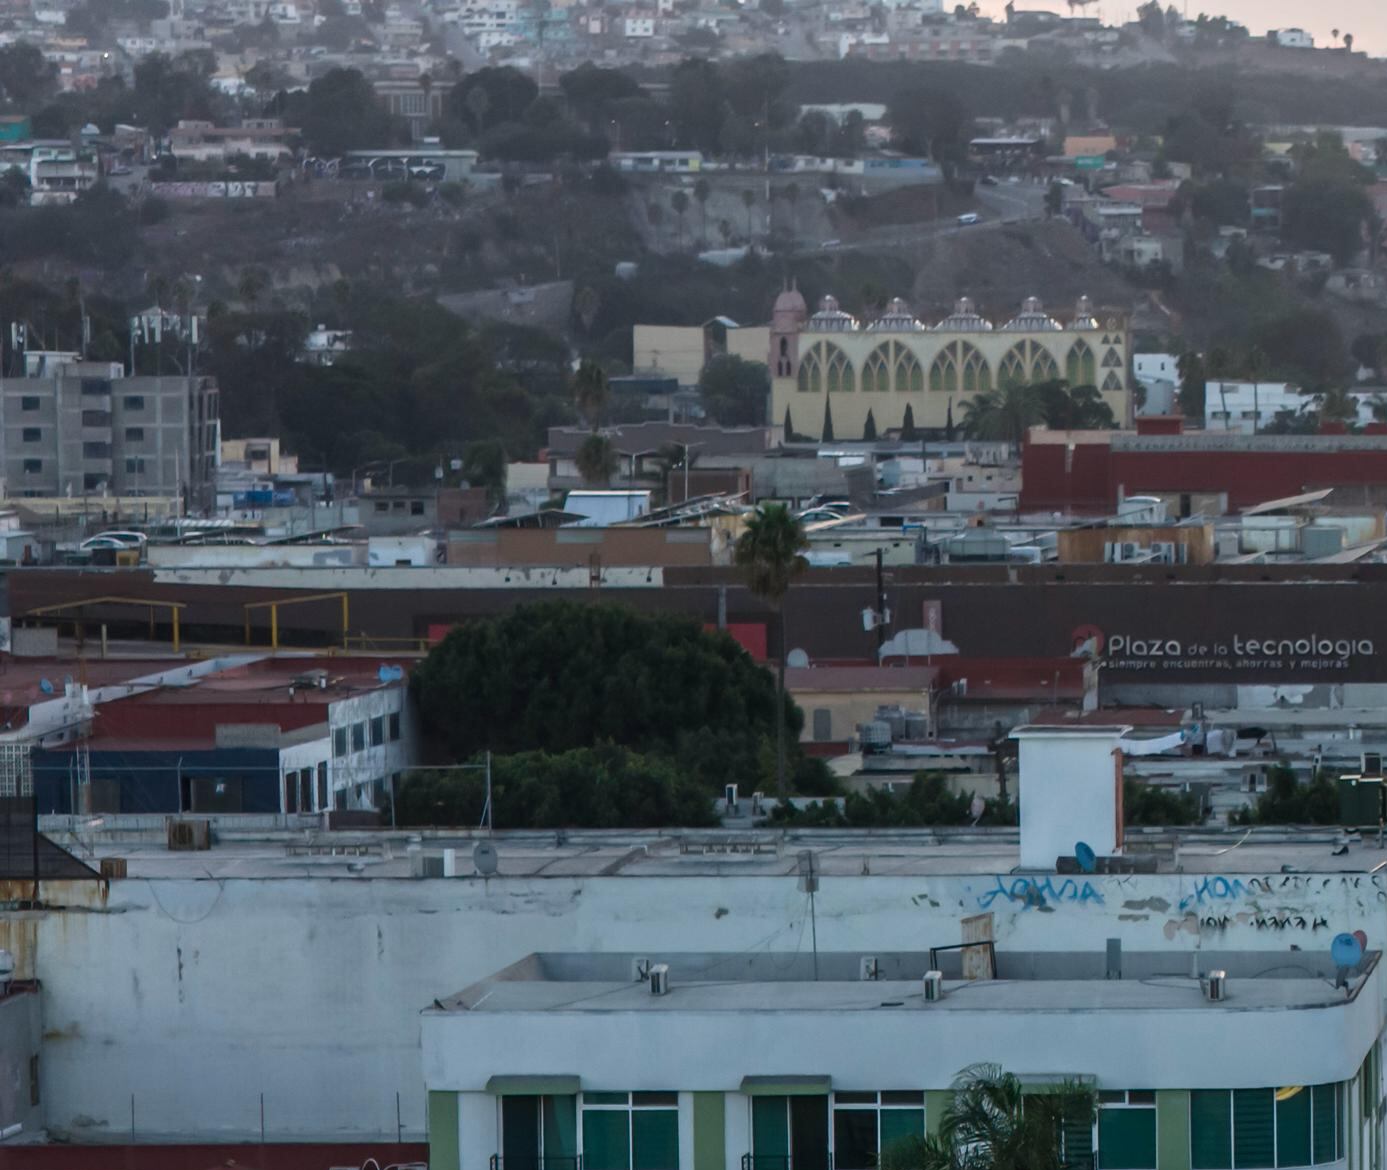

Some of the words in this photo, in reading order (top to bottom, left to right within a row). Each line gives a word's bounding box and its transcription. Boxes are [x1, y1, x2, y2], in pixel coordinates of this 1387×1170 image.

[1108, 634, 1182, 656] Plaza
[1188, 642, 1207, 656] de
[1213, 642, 1228, 656] la
[1108, 659, 1156, 670] siempre
[1236, 658, 1283, 669] ahorras
[1301, 658, 1350, 670] mejoras
